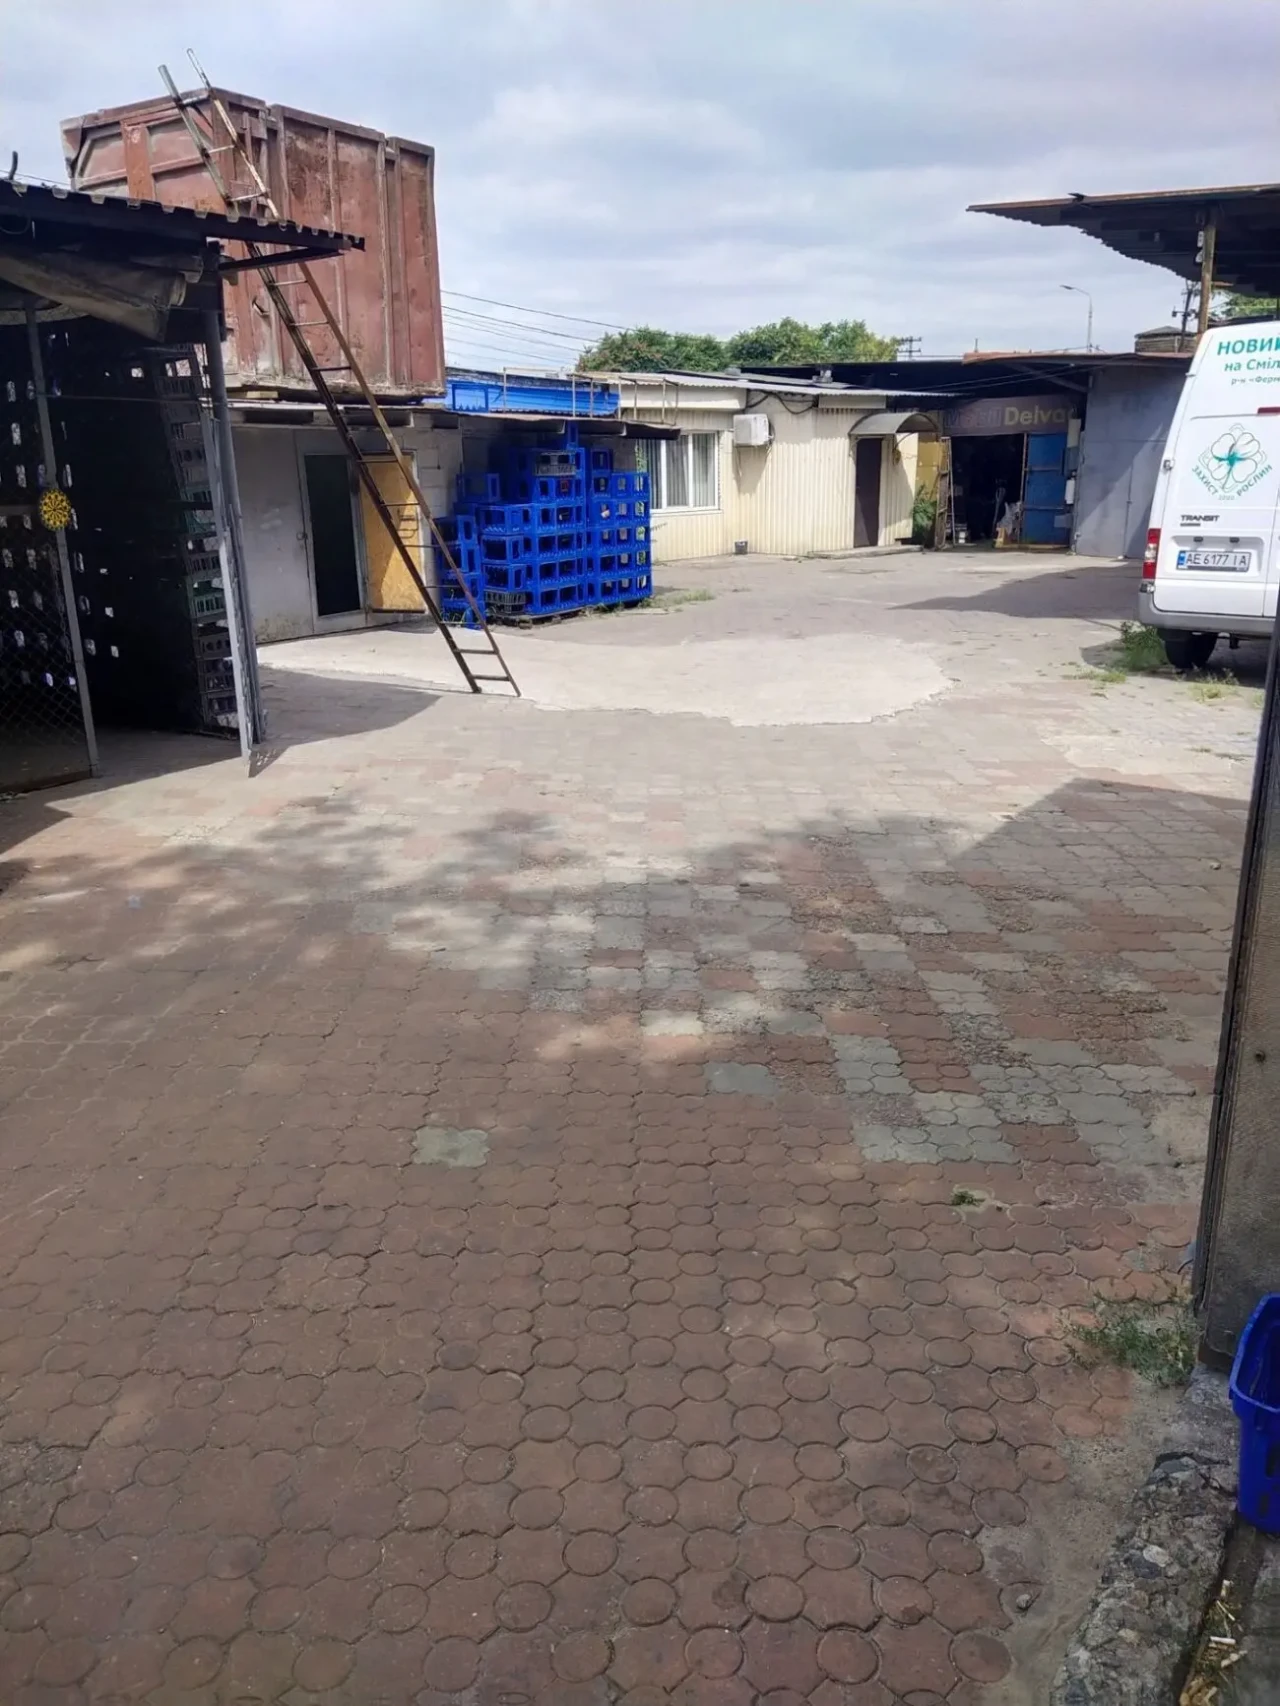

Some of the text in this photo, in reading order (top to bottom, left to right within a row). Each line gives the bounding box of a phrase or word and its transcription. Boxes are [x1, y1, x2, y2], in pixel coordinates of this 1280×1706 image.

[1224, 362, 1242, 372] на
[1191, 464, 1273, 497] ЗАХИСТ РОСЛИН
[1180, 514, 1220, 522] TRANSIT
[1186, 553, 1202, 565] AE
[1203, 554, 1230, 566] 6177
